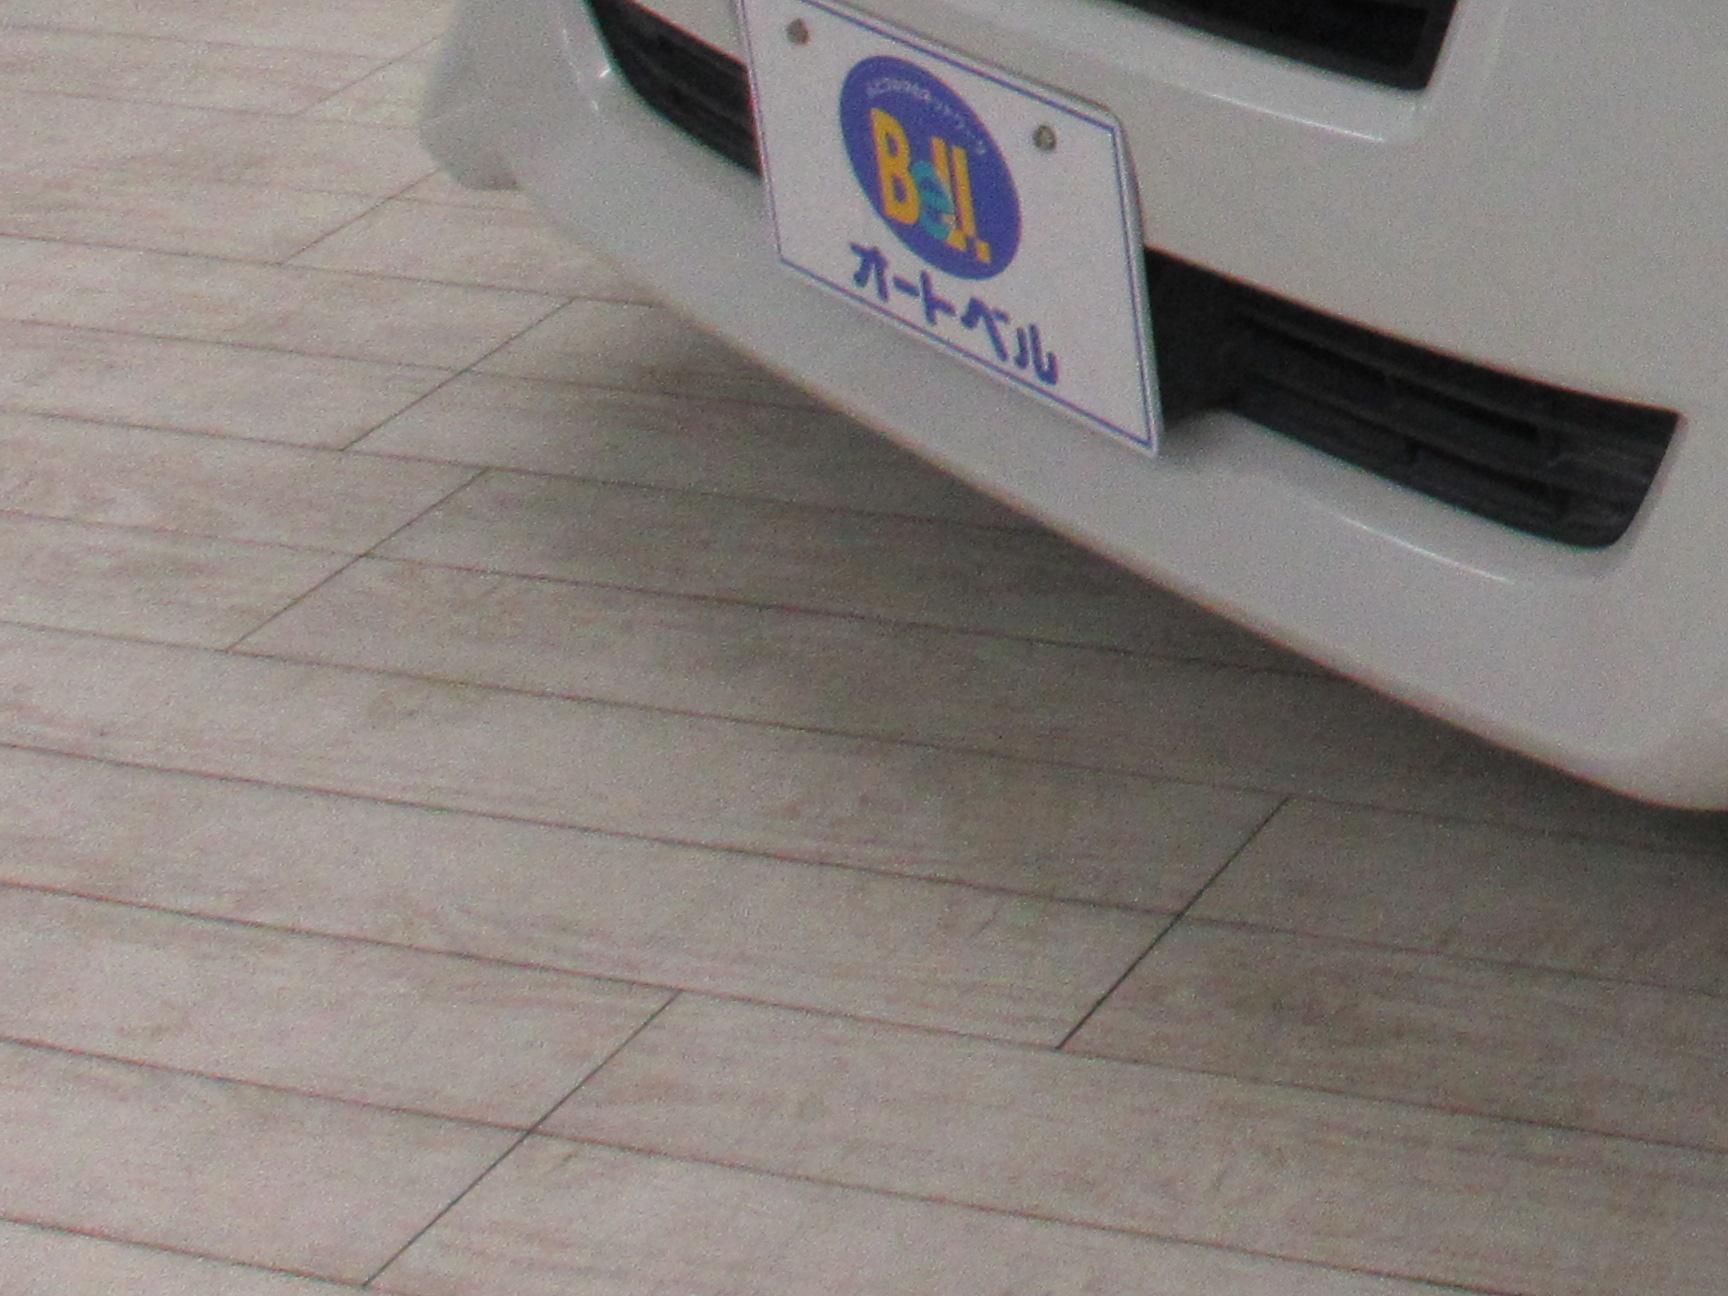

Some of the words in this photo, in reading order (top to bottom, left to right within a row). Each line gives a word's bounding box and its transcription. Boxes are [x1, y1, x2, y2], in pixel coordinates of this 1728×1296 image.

[850, 241, 1059, 386] オートベル
